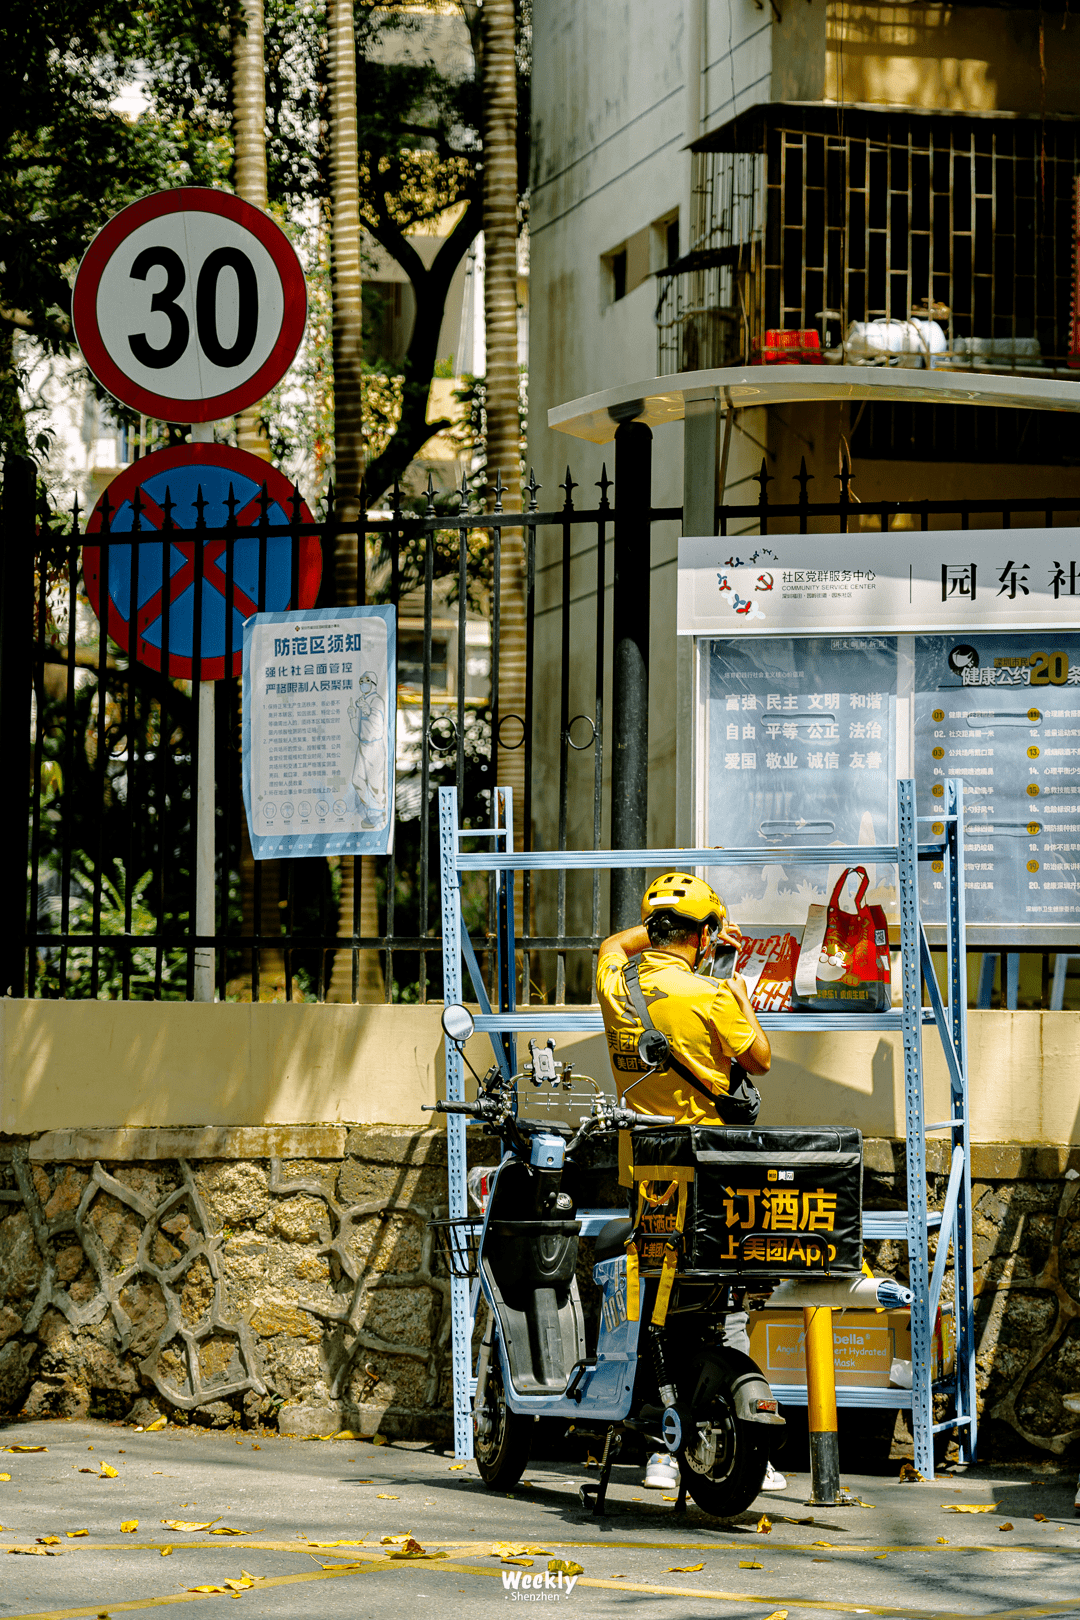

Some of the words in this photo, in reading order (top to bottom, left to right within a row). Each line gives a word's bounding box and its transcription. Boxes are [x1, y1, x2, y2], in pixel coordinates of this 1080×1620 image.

[128, 246, 258, 369] 30
[782, 569, 876, 583] 社区党群服务中心
[941, 560, 1080, 602] 园东社
[274, 633, 361, 657] 防范区须知
[265, 662, 353, 678] 强化社会面管控
[994, 658, 1029, 668] 深圳市民
[265, 679, 353, 695] 严格限制人员聚集
[725, 694, 757, 711] 富强
[766, 693, 798, 710] 民主
[807, 693, 840, 710] 文明
[849, 692, 882, 710] 和谐
[726, 723, 756, 740] 自由
[766, 722, 799, 740] 平等
[807, 722, 840, 739] 公正
[849, 722, 882, 739] 法治
[934, 730, 946, 738] 02.
[724, 752, 757, 769] 爱国
[766, 752, 798, 769] 敬业
[807, 752, 840, 769] 诚信
[849, 751, 882, 769] 友善
[1029, 767, 1039, 775] 14.
[1029, 804, 1039, 812] 16.
[933, 882, 944, 890] 10.
[1029, 882, 1040, 890] 20.
[617, 1056, 662, 1071] 美团专
[722, 1186, 837, 1231] 订酒店
[641, 1214, 676, 1233] 订酒店
[721, 1235, 836, 1267] 上美团App
[776, 1345, 797, 1355] Angel
[849, 1347, 887, 1357] Hydrated
[834, 1359, 855, 1367] Mask
